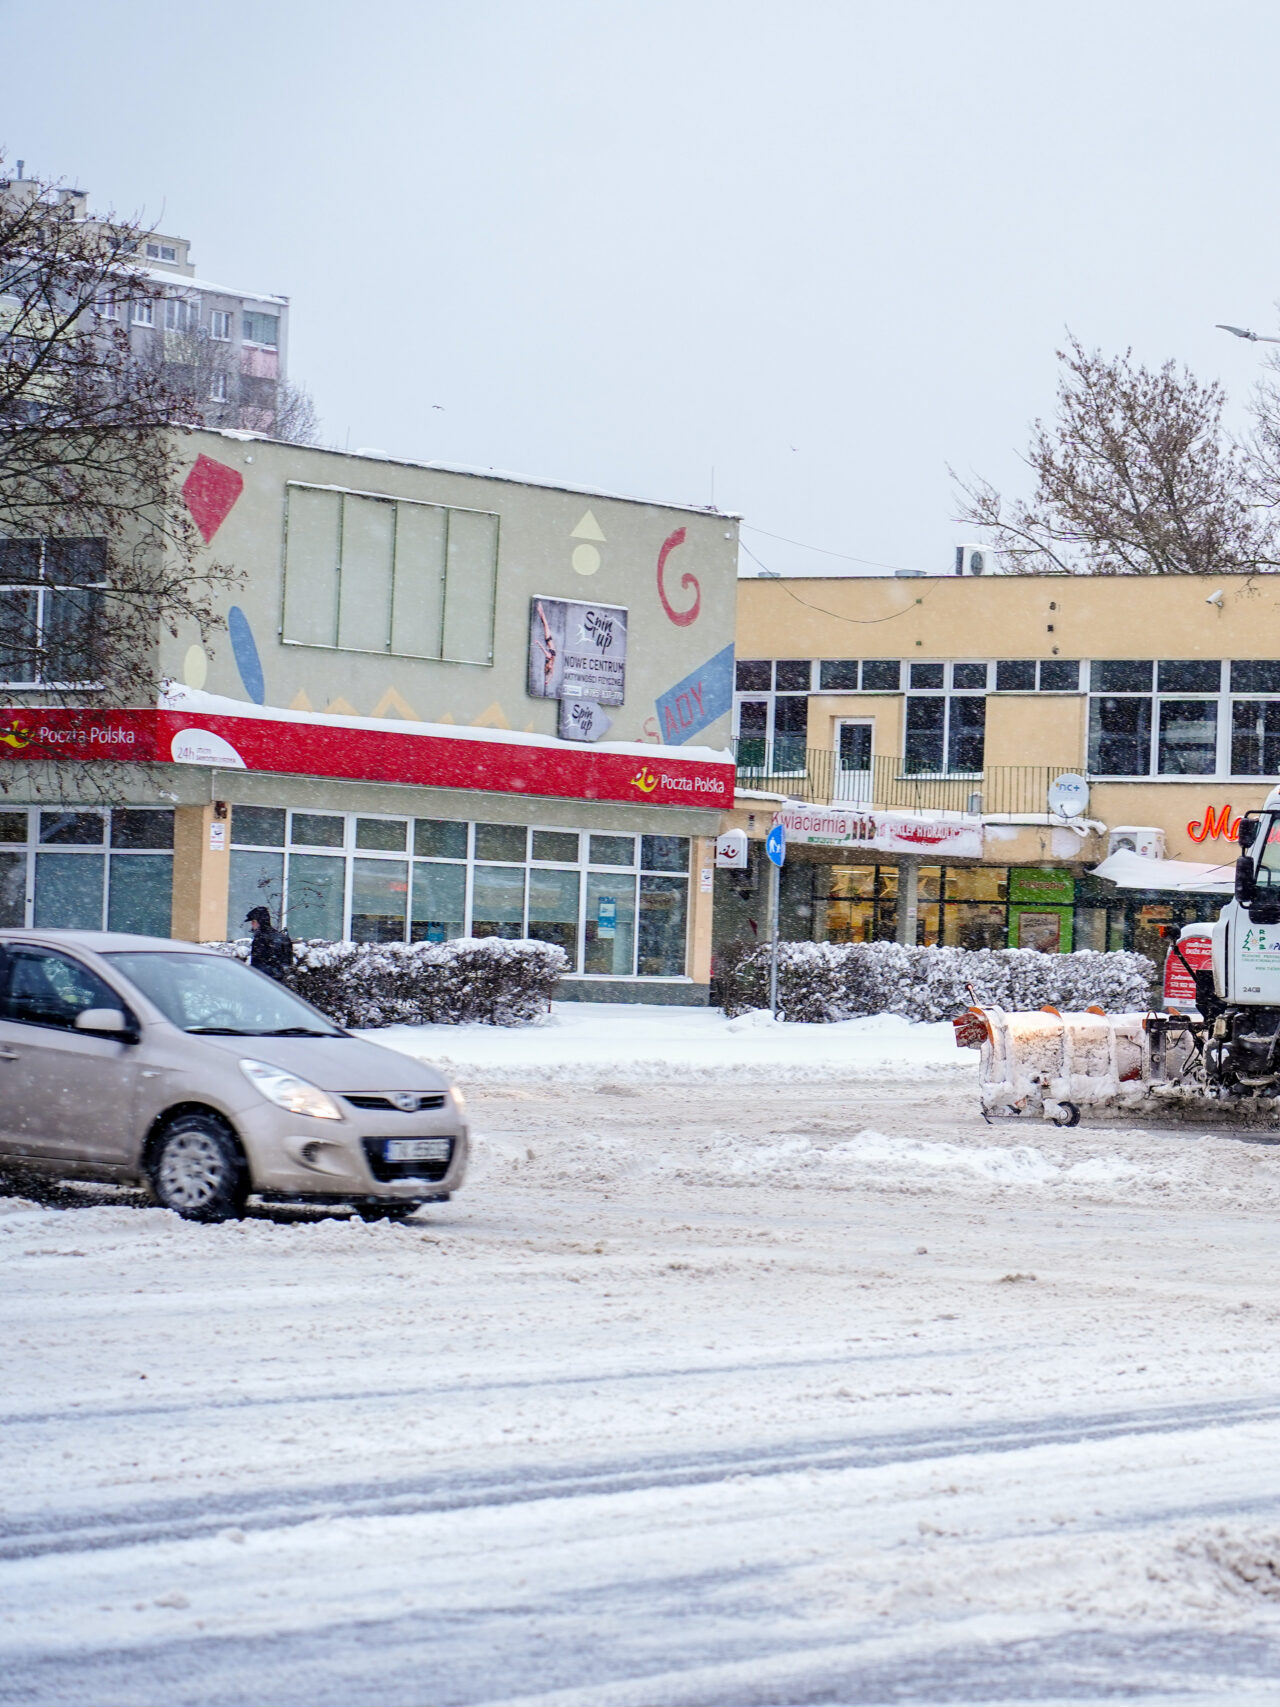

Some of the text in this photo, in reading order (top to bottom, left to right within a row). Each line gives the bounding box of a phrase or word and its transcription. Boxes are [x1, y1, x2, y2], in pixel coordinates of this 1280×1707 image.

[565, 656, 625, 674] NOWE CENTRUM
[40, 726, 135, 744] Poczta Polska
[177, 746, 195, 761] 24h
[661, 774, 725, 793] Poczta Polska
[771, 811, 846, 834] Kwiaciarnia
